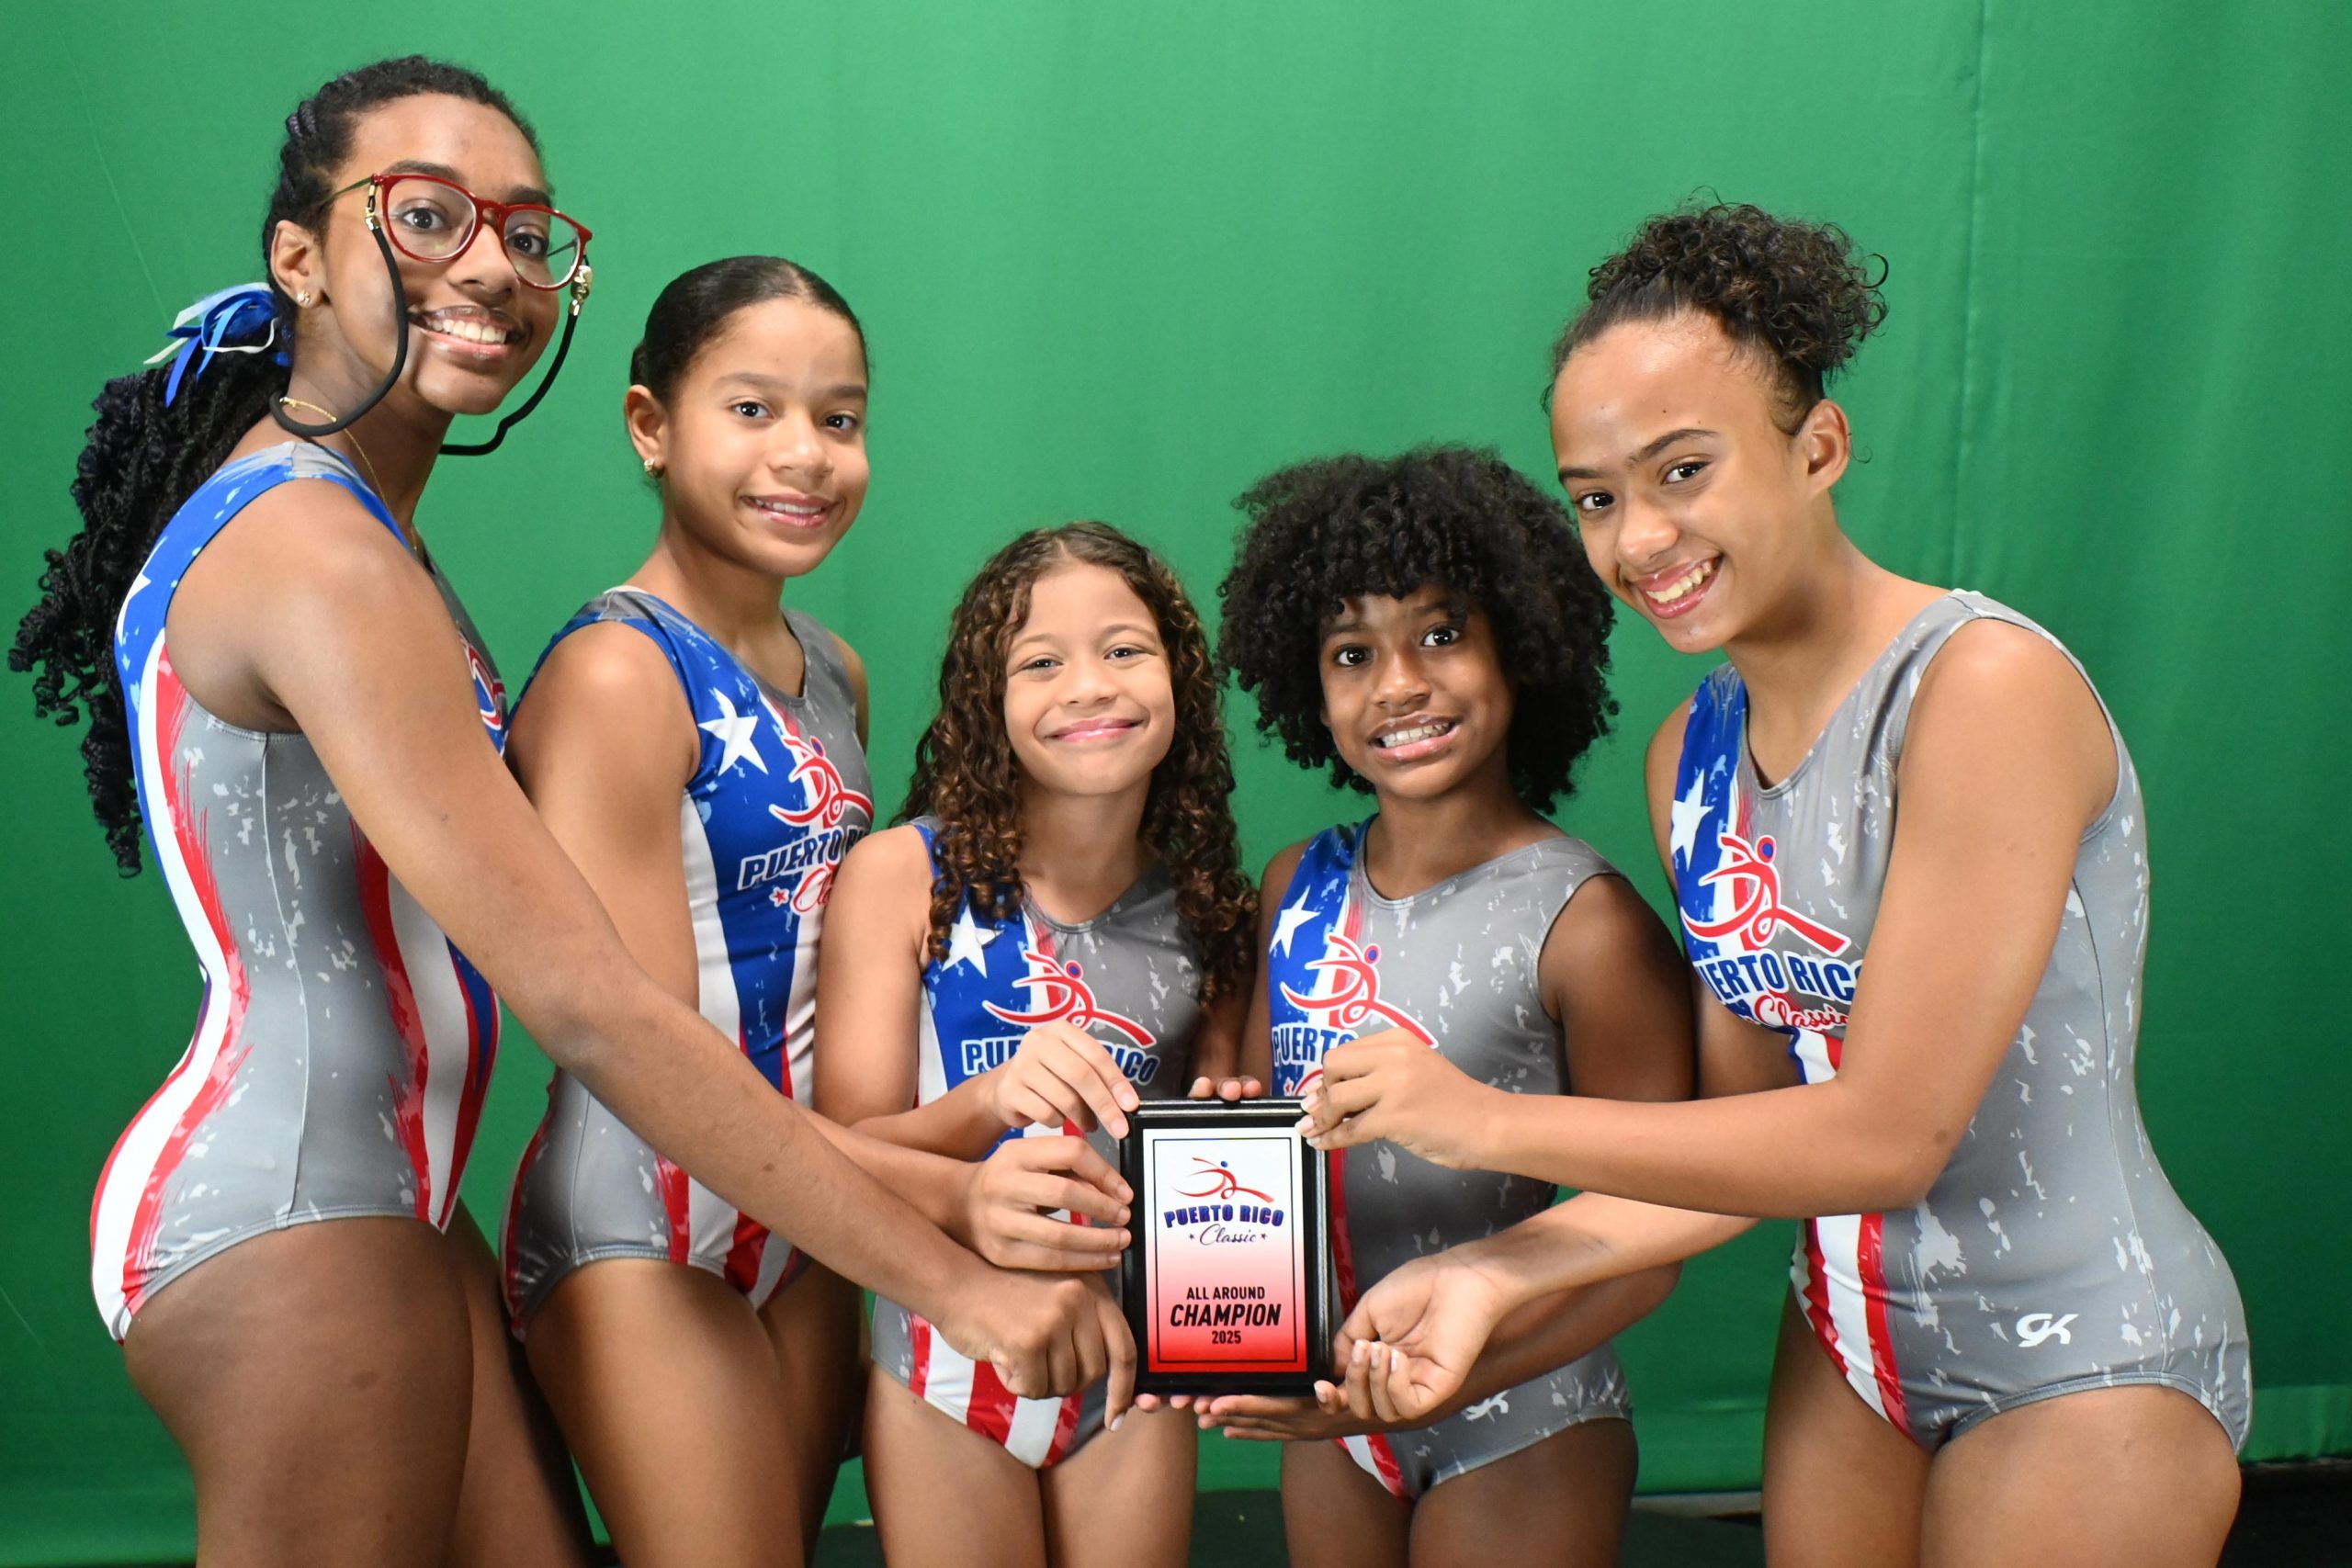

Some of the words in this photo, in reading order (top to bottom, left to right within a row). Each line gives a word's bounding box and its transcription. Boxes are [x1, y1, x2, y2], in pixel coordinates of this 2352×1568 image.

[740, 829, 844, 889] PUERTO
[1787, 955, 1862, 1001] RIC
[1102, 1043, 1159, 1083] ICO
[1163, 1204, 1234, 1228] PUERTO
[1239, 1204, 1284, 1227] RICO
[1199, 1224, 1257, 1246] Classic
[1186, 1286, 1209, 1300] ALL
[1213, 1286, 1265, 1300] AROUND
[1170, 1303, 1282, 1327] CHAMPION
[1211, 1330, 1242, 1345] 2025
[2016, 1313, 2079, 1348] GK
